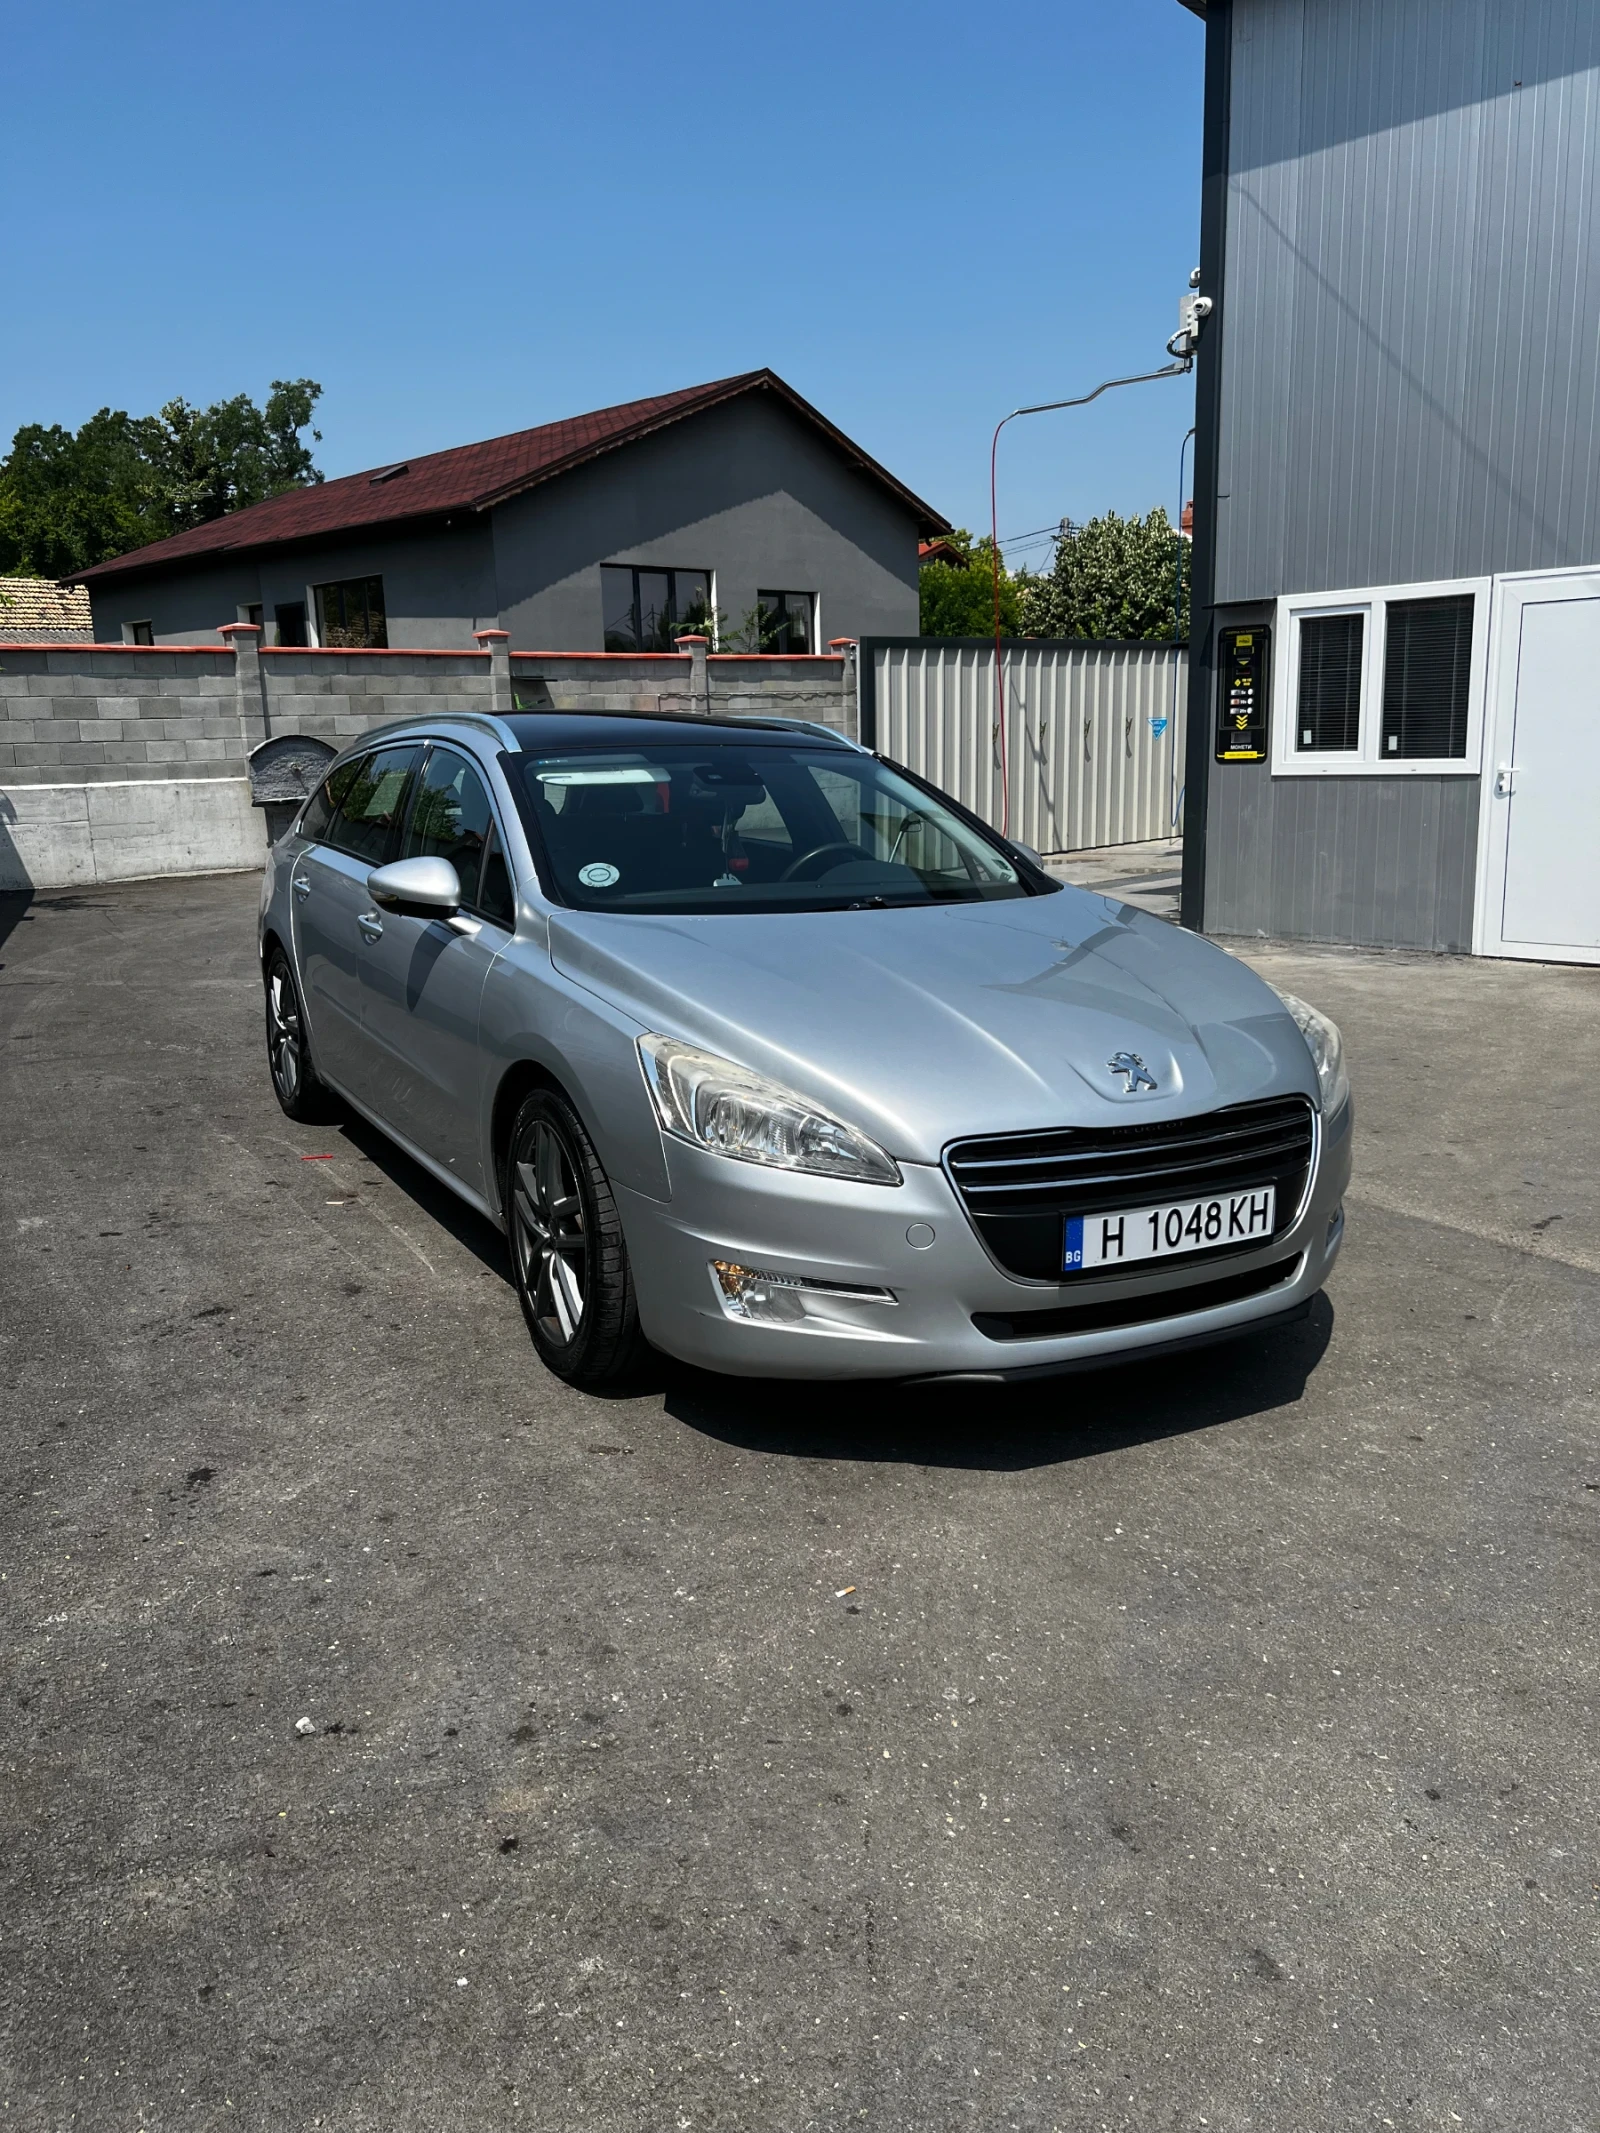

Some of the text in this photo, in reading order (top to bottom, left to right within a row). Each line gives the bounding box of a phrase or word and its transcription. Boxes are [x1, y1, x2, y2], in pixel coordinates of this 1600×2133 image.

[1112, 1121, 1185, 1136] PEUGEOT
[1101, 1216, 1125, 1259] H
[1065, 1250, 1081, 1264] BG
